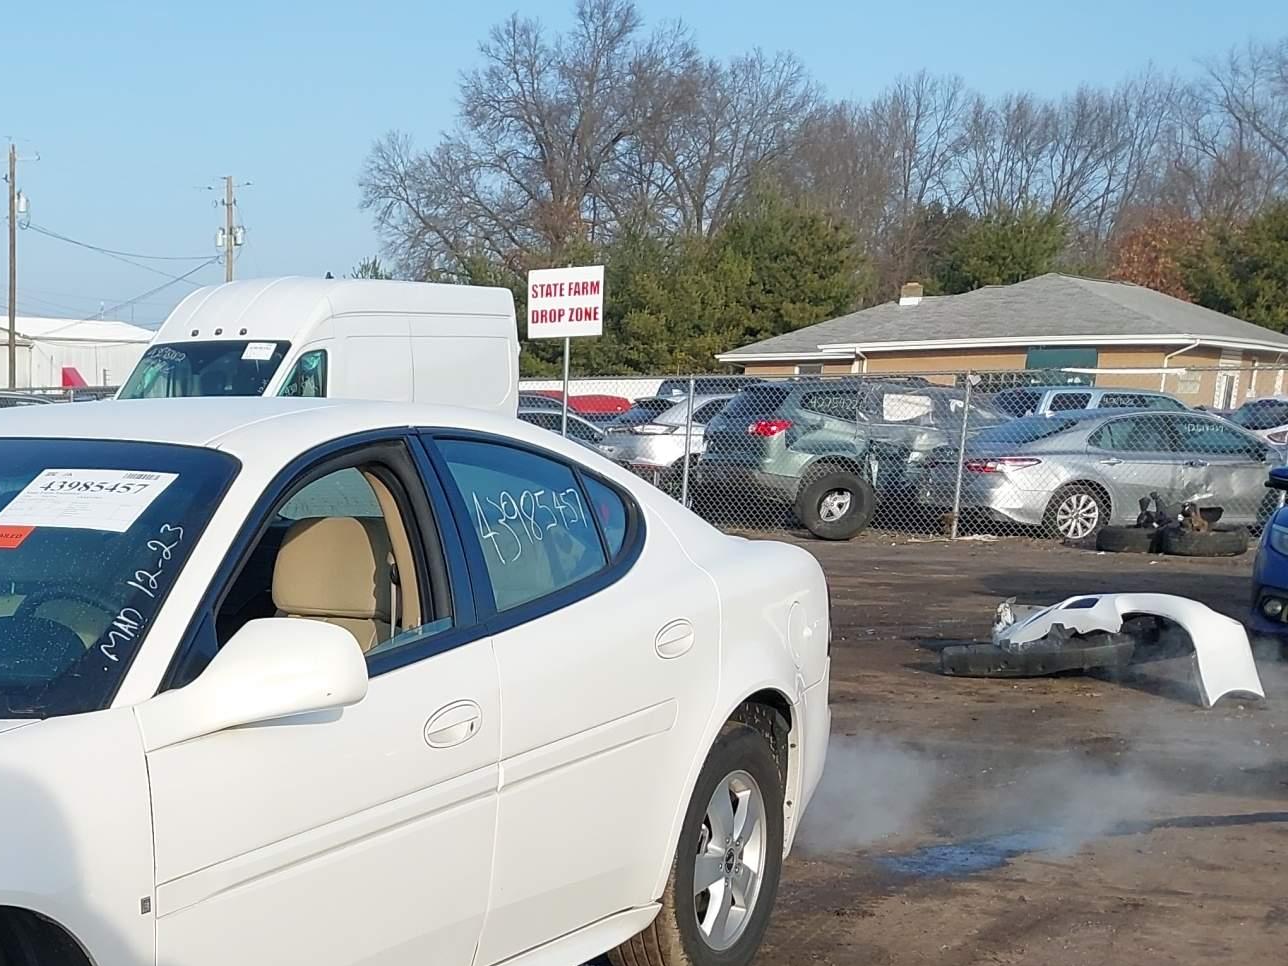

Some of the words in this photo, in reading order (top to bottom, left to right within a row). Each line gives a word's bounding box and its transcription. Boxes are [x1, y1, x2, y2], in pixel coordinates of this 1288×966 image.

[531, 283, 565, 298] STATE
[568, 280, 601, 296] FARM
[531, 309, 565, 324] DROP
[568, 306, 599, 322] ZONE
[40, 480, 149, 495] 43985457
[472, 488, 588, 565] 43985457
[126, 523, 184, 598] 12-23
